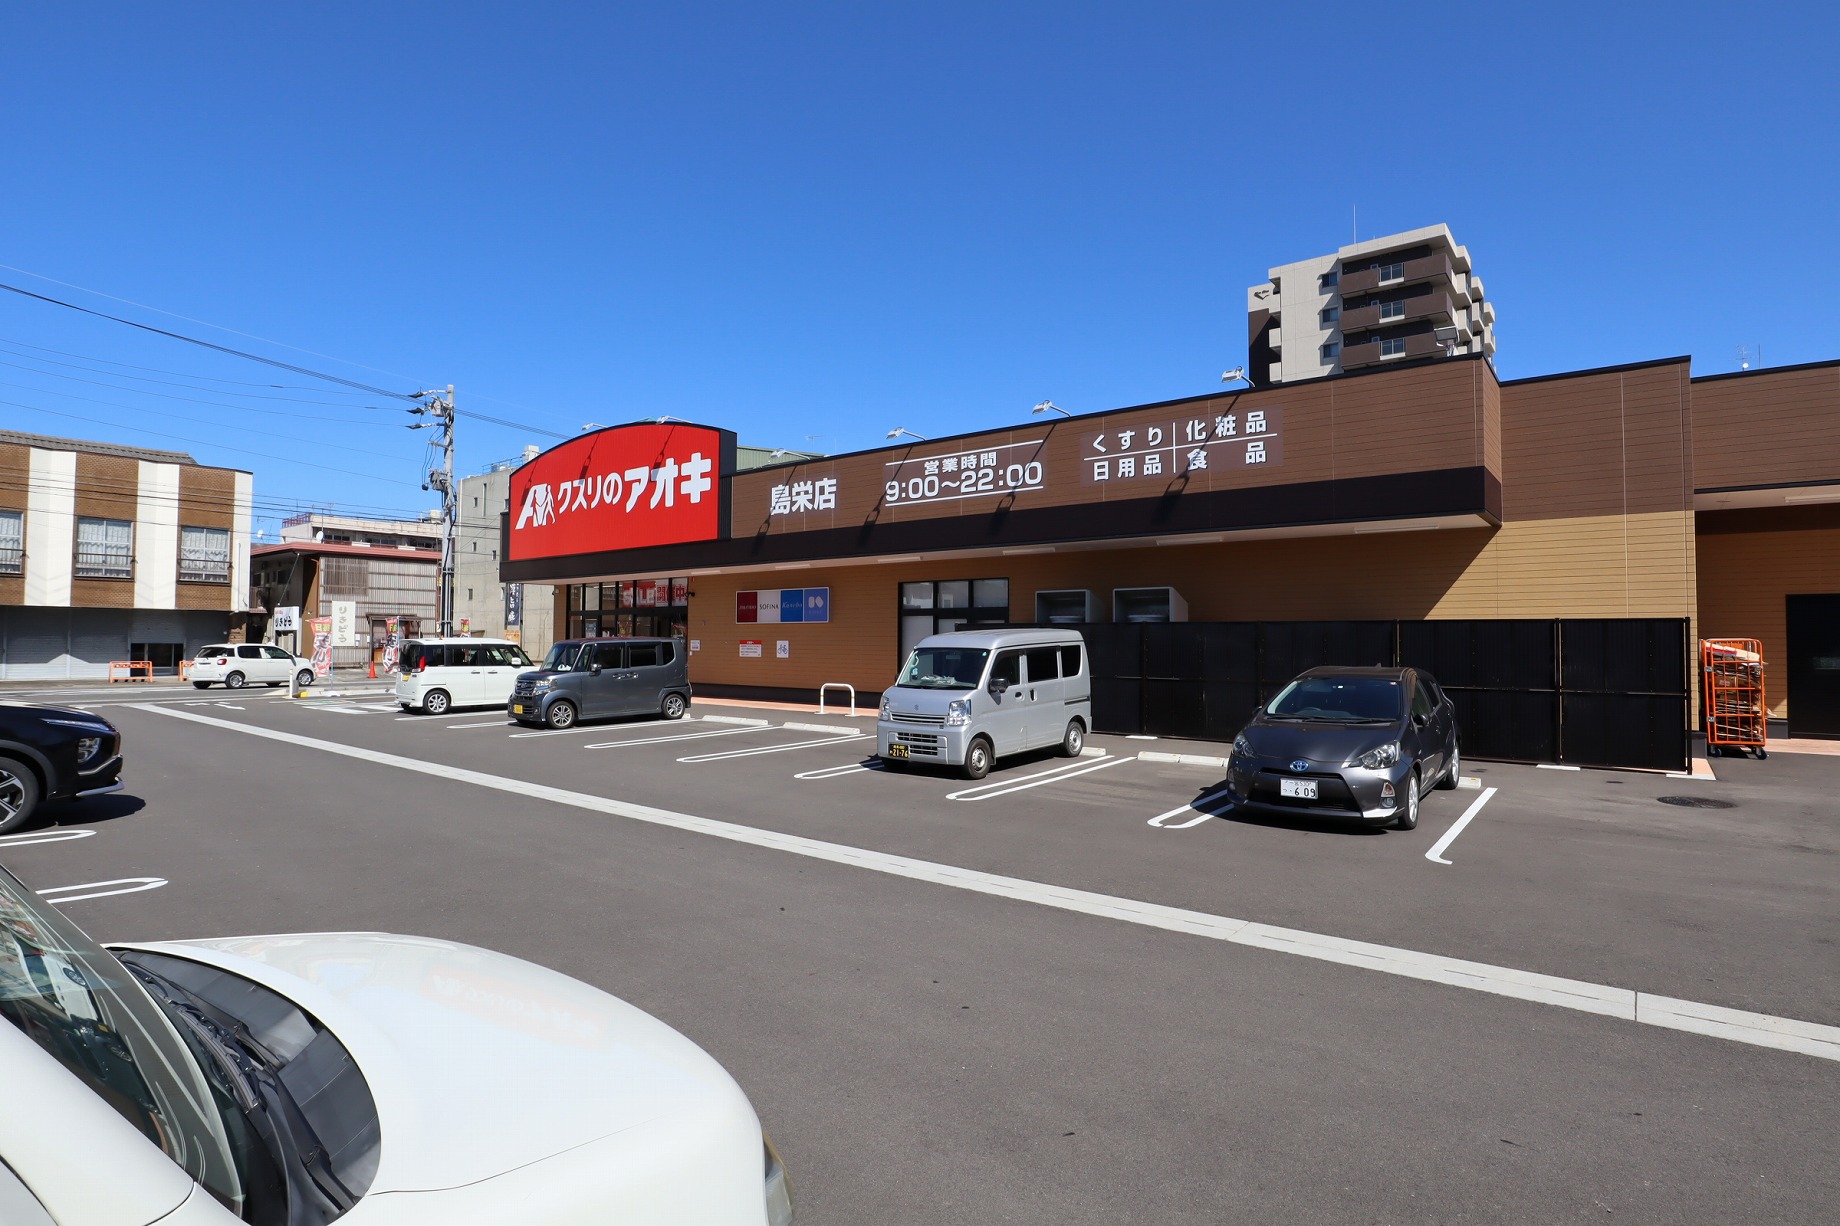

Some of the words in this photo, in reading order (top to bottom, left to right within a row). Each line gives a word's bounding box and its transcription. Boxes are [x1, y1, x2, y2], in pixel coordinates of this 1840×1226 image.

[1092, 426, 1163, 453] くすり
[1185, 410, 1268, 442] 化粧品
[924, 451, 998, 476] 営業時間
[1093, 454, 1163, 482] 日用品
[557, 452, 712, 514] クスリのアオキ
[770, 477, 837, 516] 島栄店
